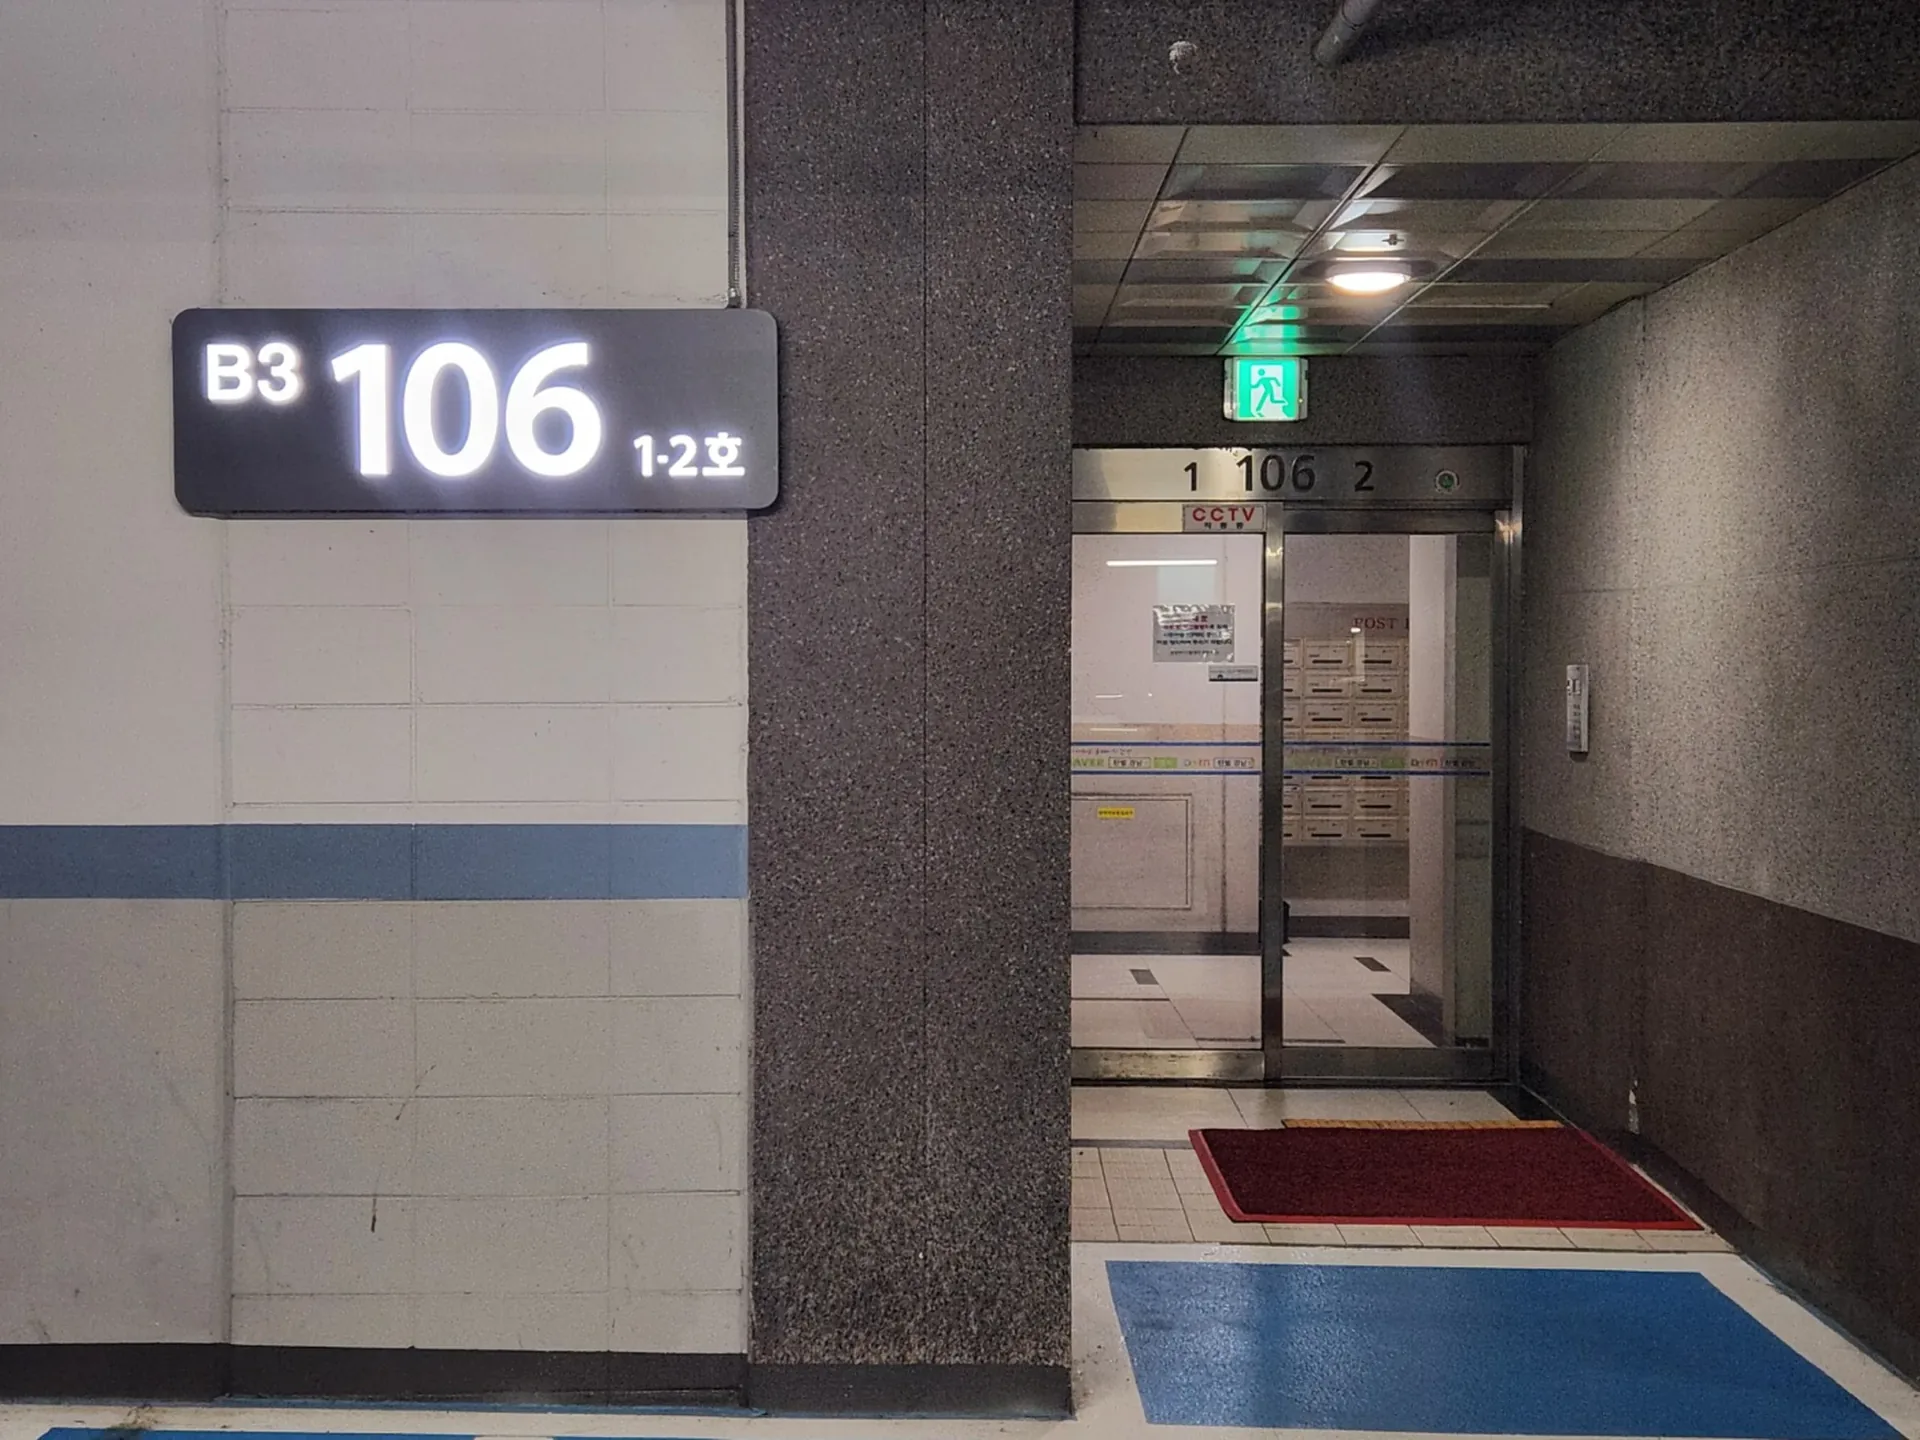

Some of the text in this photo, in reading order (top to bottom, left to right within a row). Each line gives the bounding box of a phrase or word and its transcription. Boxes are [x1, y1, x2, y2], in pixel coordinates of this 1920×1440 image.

[206, 342, 602, 477] B3 106
[1184, 454, 1374, 492] 1 106 2
[1192, 506, 1255, 522] CCTV
[1353, 617, 1399, 630] POST
